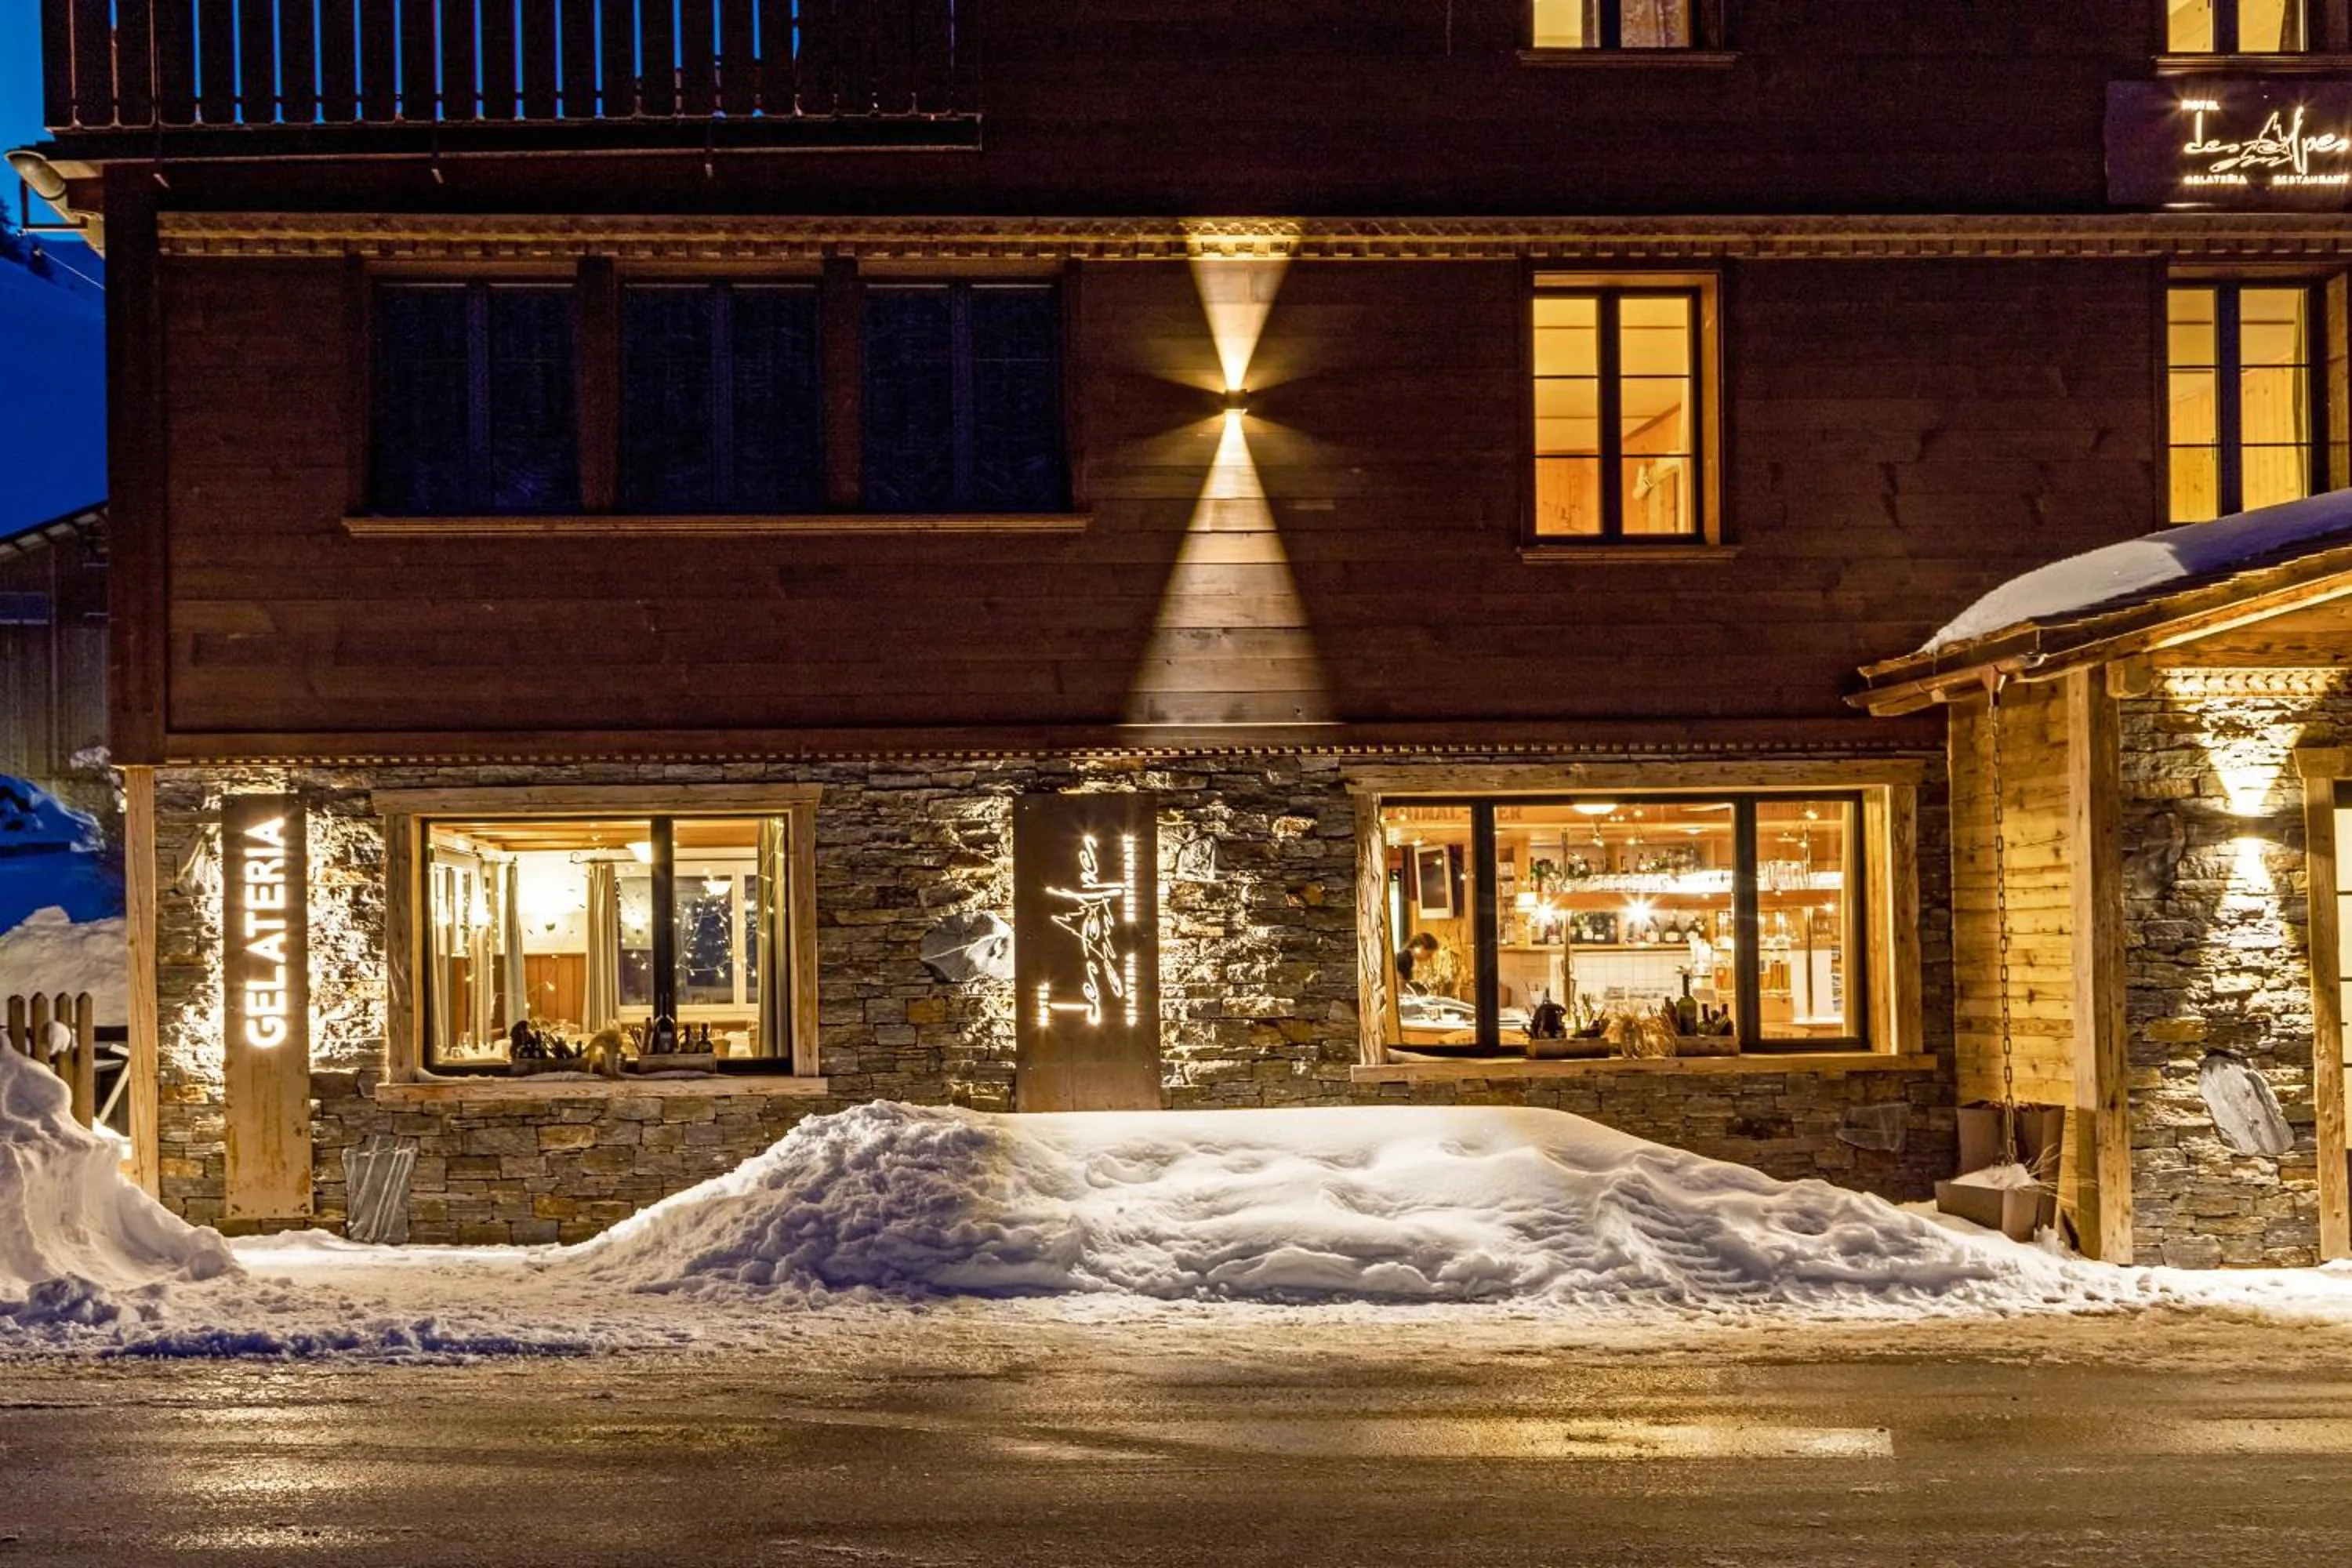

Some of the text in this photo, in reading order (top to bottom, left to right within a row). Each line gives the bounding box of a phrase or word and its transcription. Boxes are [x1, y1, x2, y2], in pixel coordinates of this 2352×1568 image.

[2181, 99, 2220, 111] HOTEL
[2183, 174, 2249, 185] GELATERIA
[2272, 174, 2350, 185] RESTAURANT
[1122, 833, 1137, 923] RESTAURANT
[244, 815, 288, 1049] GELATERIA
[1037, 982, 1051, 1027] HOTEL
[1123, 952, 1137, 1027] GELATERIA
